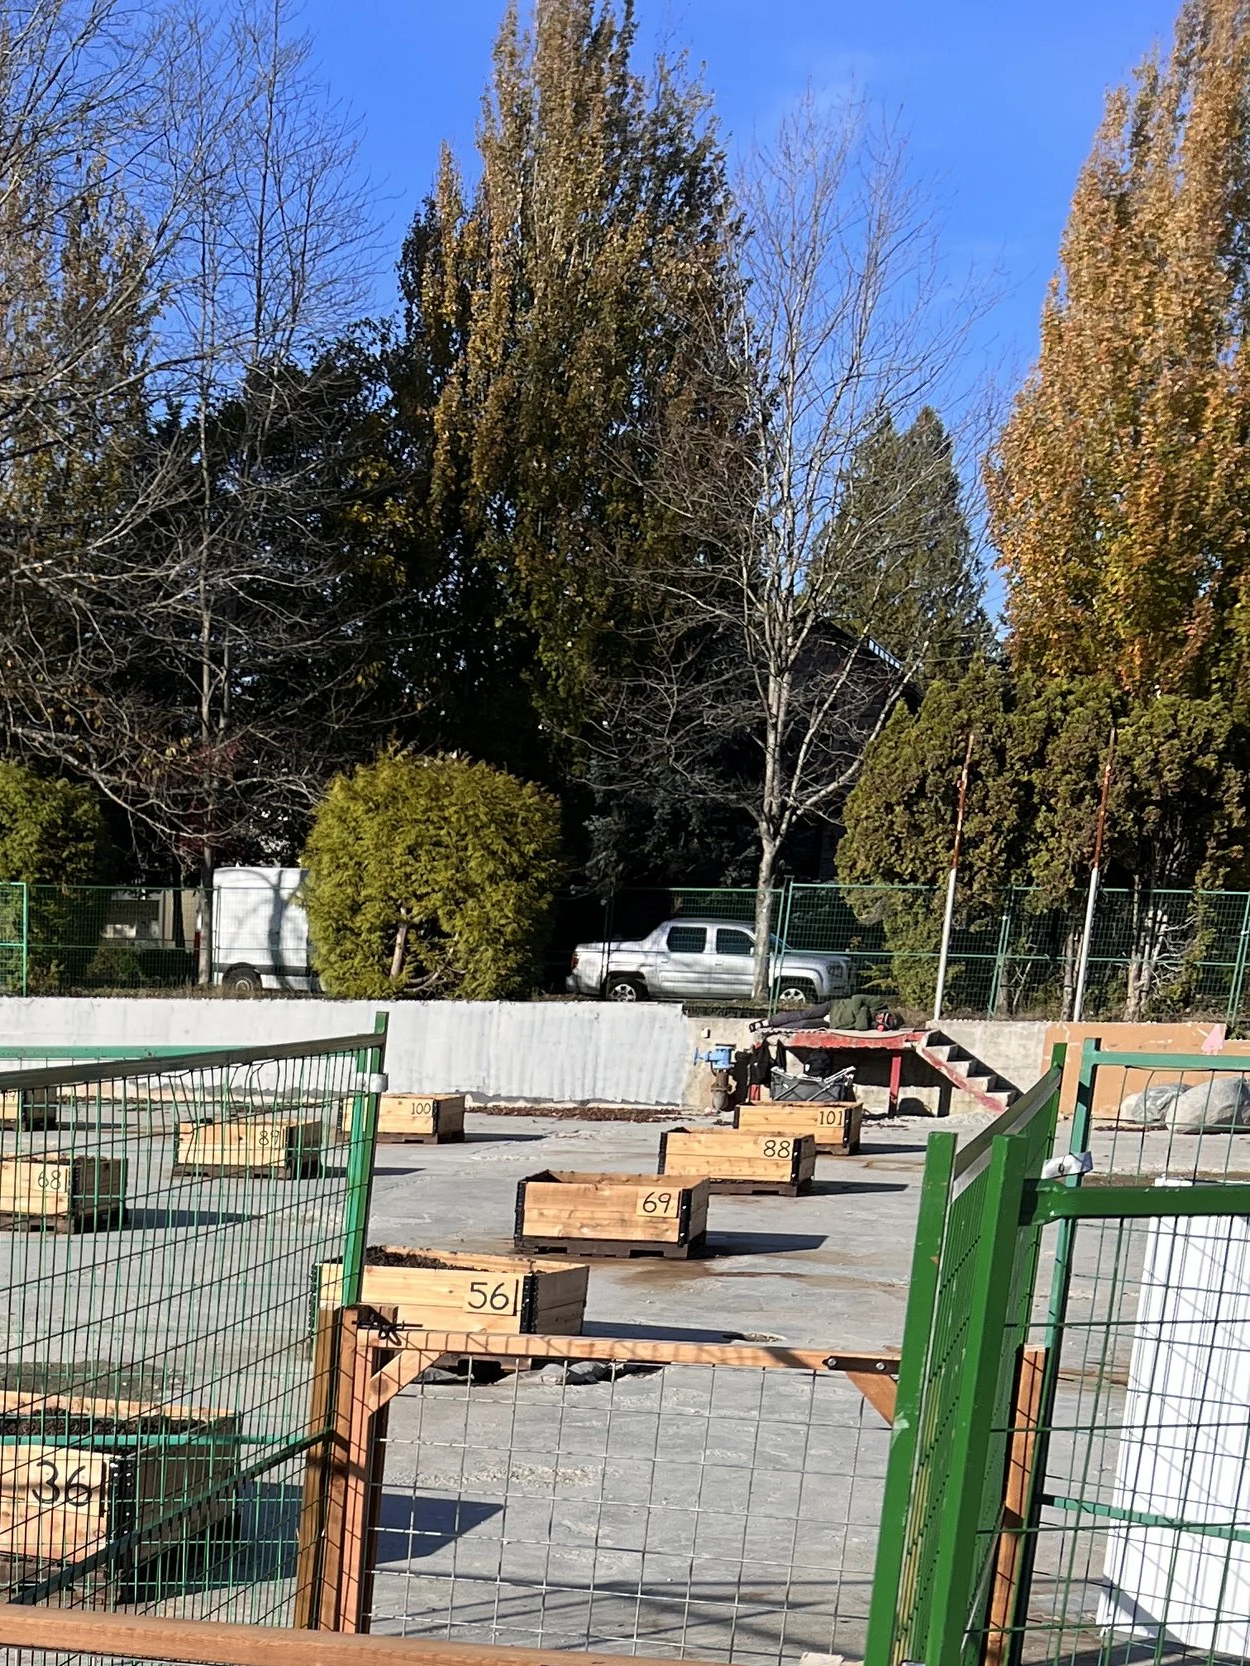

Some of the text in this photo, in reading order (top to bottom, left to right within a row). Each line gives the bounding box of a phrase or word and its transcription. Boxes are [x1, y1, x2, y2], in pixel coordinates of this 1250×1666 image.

[411, 1102, 432, 1115] 100
[819, 1110, 843, 1126] 101
[258, 1129, 280, 1147] 89
[763, 1139, 791, 1158] 88
[37, 1169, 62, 1190] 68
[642, 1191, 672, 1214] 69
[468, 1282, 510, 1310] 56
[32, 1460, 93, 1507] 36
